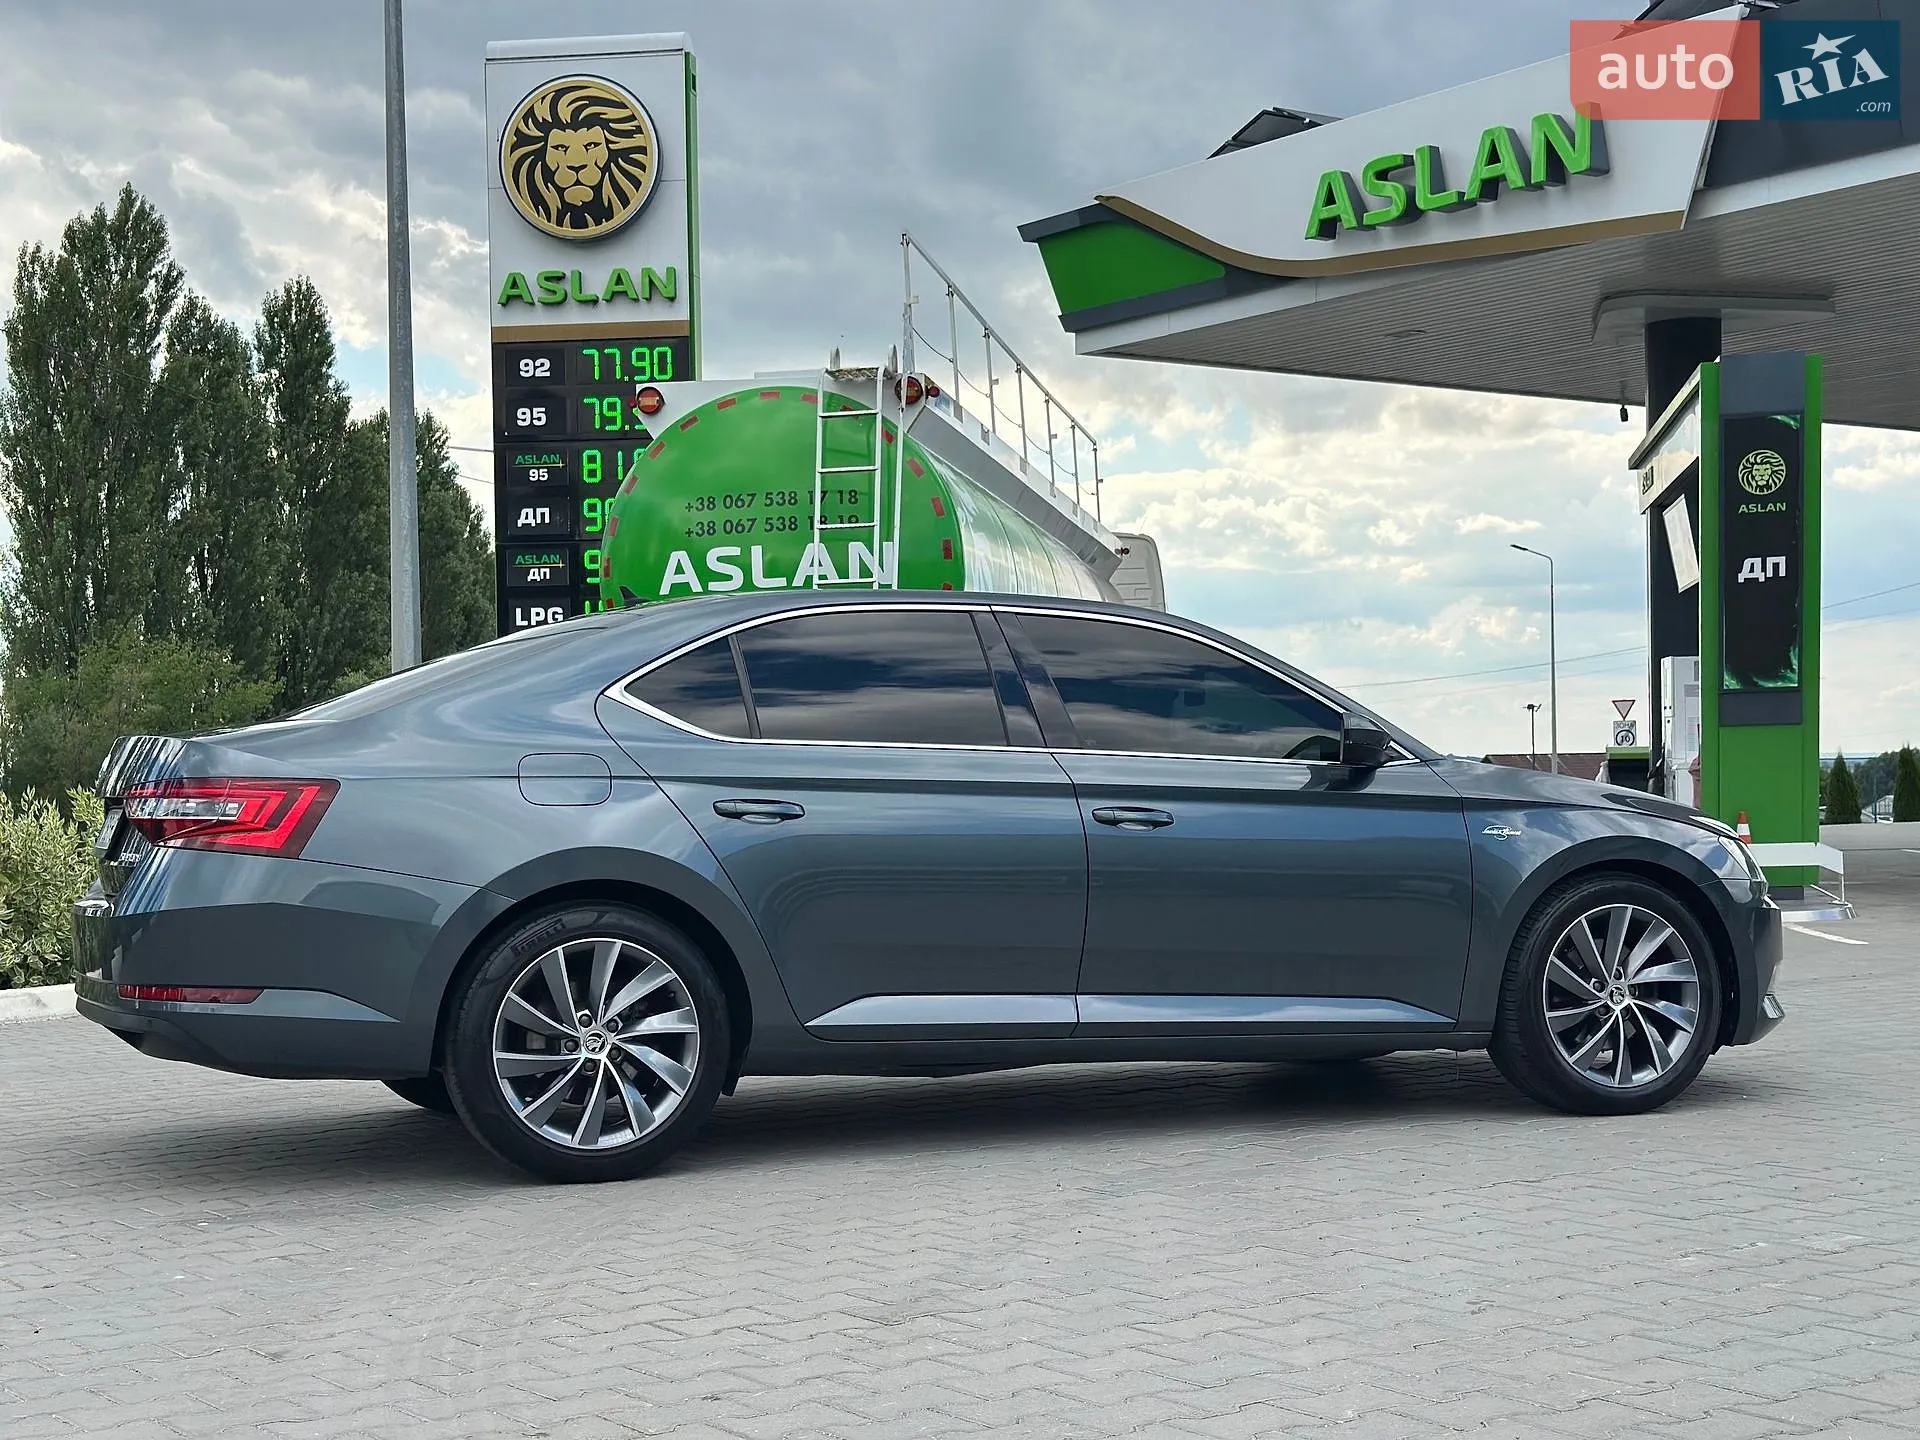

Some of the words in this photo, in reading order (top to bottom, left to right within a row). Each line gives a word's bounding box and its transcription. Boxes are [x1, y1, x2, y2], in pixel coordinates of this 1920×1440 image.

[1304, 102, 1611, 240] ASLAN
[497, 266, 678, 306] ASLAN
[519, 358, 551, 377] 92
[582, 347, 673, 381] 77.90
[516, 407, 547, 426] 95
[515, 454, 560, 465] ASLAN
[529, 469, 549, 481] 95
[685, 496, 716, 513] +38
[723, 493, 756, 510] 067
[764, 490, 798, 507] 538
[837, 489, 859, 505] 18
[1738, 502, 1787, 513] ASLAN
[517, 508, 550, 527] ДП
[685, 520, 716, 537] +38
[723, 518, 756, 535] 067
[764, 515, 798, 532] 538
[515, 554, 560, 565] ASLAN
[659, 541, 896, 596] ASLAN
[527, 568, 551, 581] ДП
[1738, 556, 1787, 583] ДП
[515, 608, 564, 627] LPG
